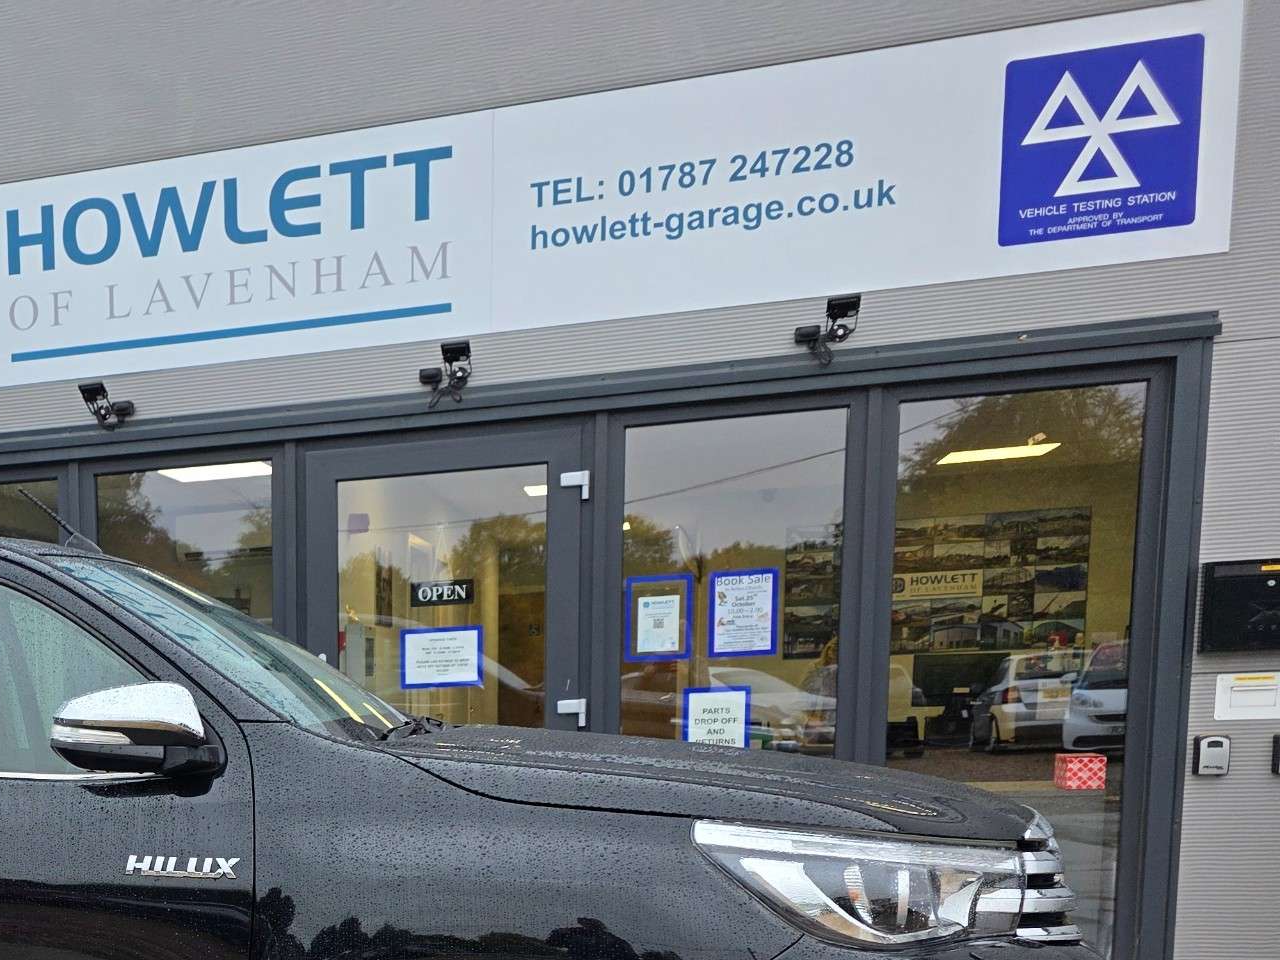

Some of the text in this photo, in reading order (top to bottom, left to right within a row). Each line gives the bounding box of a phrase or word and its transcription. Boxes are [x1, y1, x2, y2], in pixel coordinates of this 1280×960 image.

[530, 139, 855, 208] TEL: 01787 247228
[6, 145, 453, 276] HOWLETT
[530, 179, 897, 250] howlett-garage.co.uk
[1019, 191, 1177, 219] VEHICLE TESTING STATION
[1029, 213, 1164, 237] THE DEPARTMENT OF TRANSPORT
[1067, 211, 1124, 224] APPROVED BY
[8, 240, 453, 332] OF LAVENHAM
[716, 574, 771, 587] Book Sale
[910, 572, 979, 587] HOWLETT
[418, 584, 467, 602] OPEN
[694, 717, 738, 726] DROP OFF
[702, 707, 731, 715] PARTS
[706, 728, 726, 736] AND
[125, 854, 241, 879] HILUX
